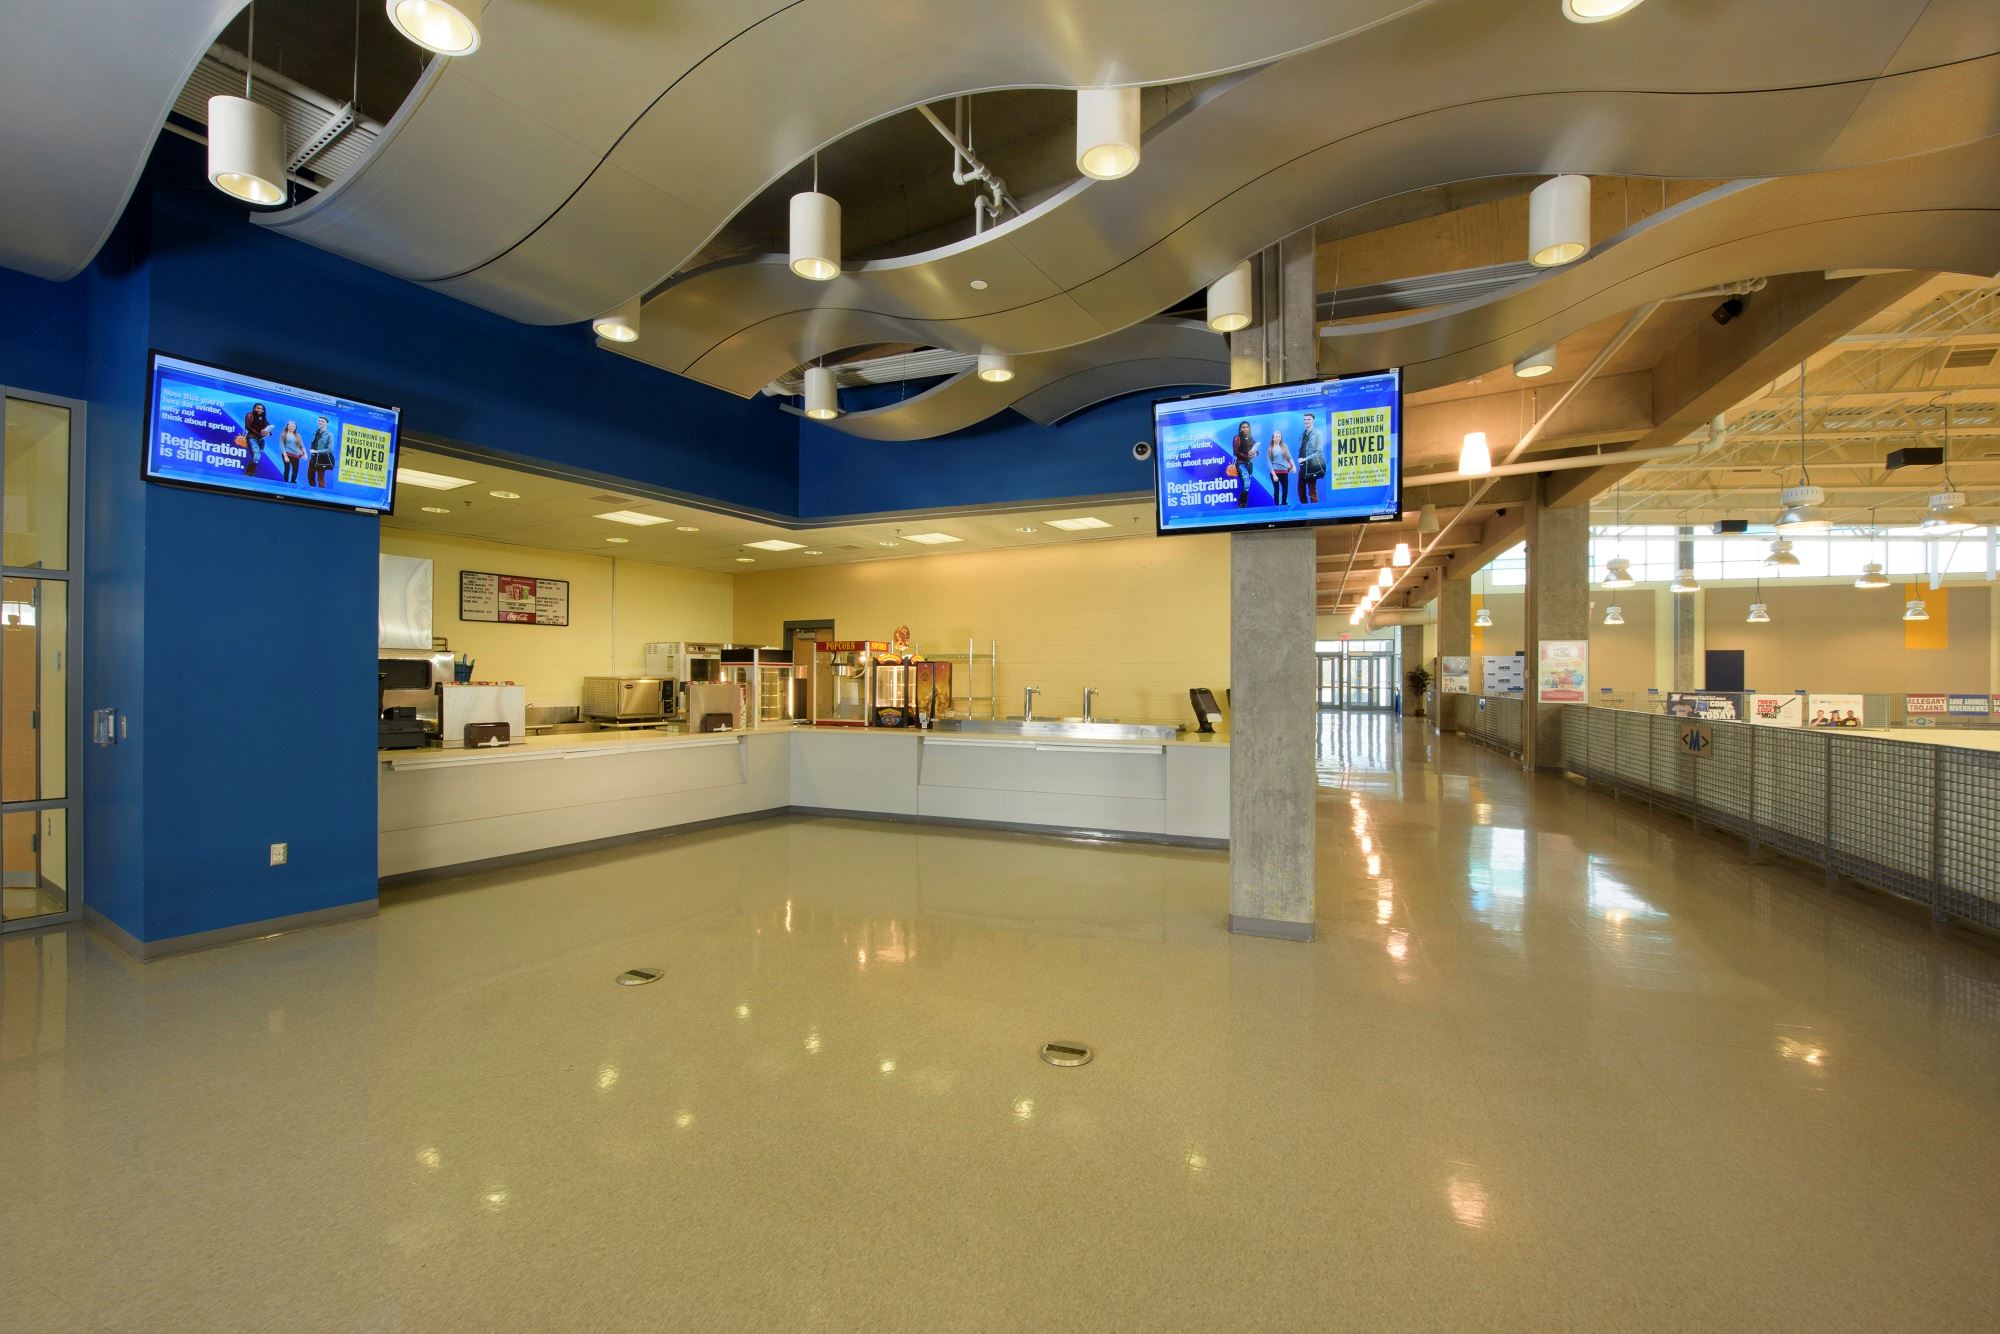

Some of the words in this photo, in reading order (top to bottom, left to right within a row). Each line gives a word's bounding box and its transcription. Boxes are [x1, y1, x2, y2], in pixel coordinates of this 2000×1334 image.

[182, 400, 193, 408] for
[196, 404, 222, 415] winter,
[182, 408, 195, 416] not
[162, 412, 183, 422] think
[184, 417, 207, 427] about
[208, 422, 236, 433] spring!
[1337, 416, 1374, 427] CONTINUING
[347, 430, 378, 441] CONTINUING
[1337, 425, 1384, 437] REGISTRATION
[160, 432, 247, 458] Registration
[347, 437, 385, 449] REGISTRATION
[1191, 441, 1213, 449] winter,
[1337, 435, 1384, 455] MOVED
[160, 444, 173, 457] is
[176, 449, 203, 462] still
[206, 454, 245, 470] open.
[346, 445, 384, 463] MOVED
[345, 458, 362, 468] NEXT
[365, 461, 383, 472] DOOR
[1183, 459, 1202, 467] about
[1202, 456, 1225, 466] spring!
[1337, 456, 1358, 467] NEXT
[1362, 454, 1383, 464] DOOR
[1167, 477, 1238, 495] Registration
[1167, 496, 1178, 506] is
[1180, 493, 1201, 506] still
[1204, 492, 1237, 506] open.
[507, 613, 528, 621] Coca-Cola
[826, 642, 855, 650] POPCORN
[871, 642, 886, 650] POPCORN
[1699, 710, 1736, 720] TODAY!
